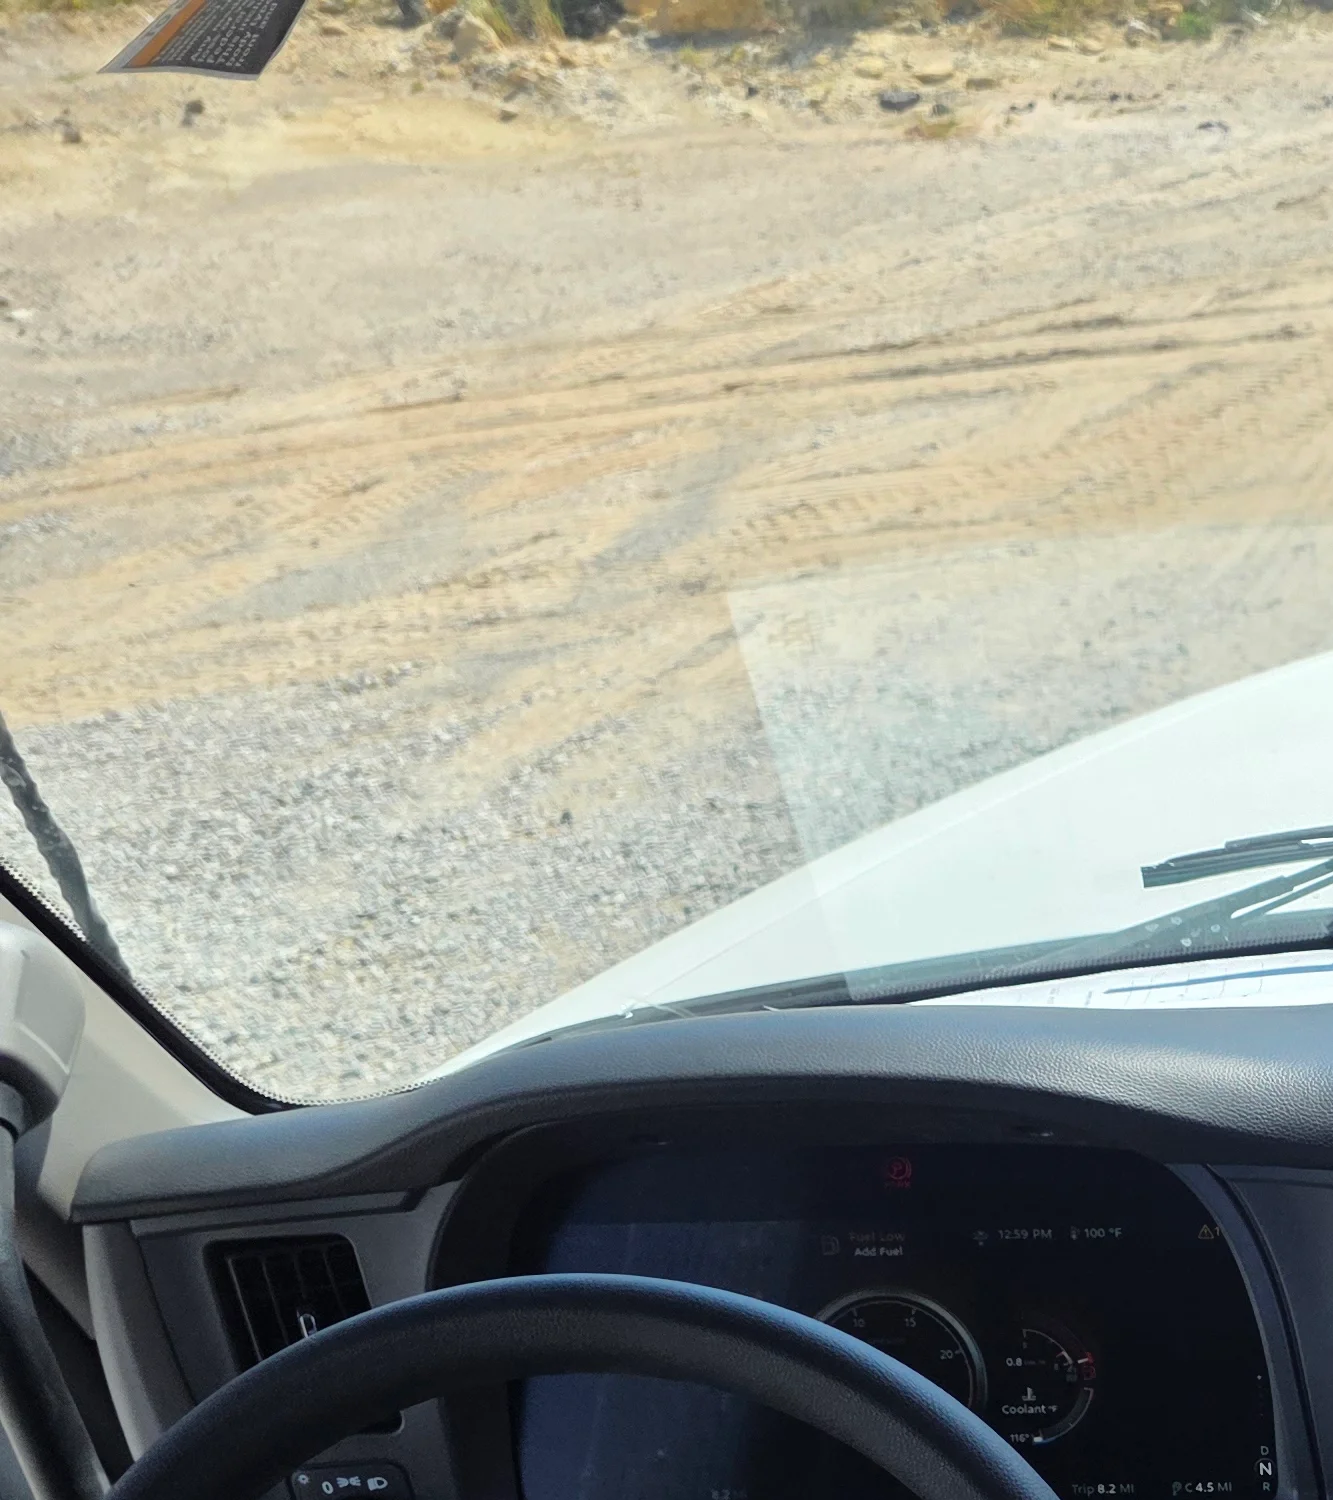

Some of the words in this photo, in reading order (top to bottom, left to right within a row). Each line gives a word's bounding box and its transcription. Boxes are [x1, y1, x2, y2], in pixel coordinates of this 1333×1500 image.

[1032, 1229, 1052, 1240] PM
[1084, 1228, 1106, 1239] 100
[854, 1247, 877, 1257] Add
[880, 1247, 903, 1257] Fuel
[1006, 1357, 1022, 1367] 0.8
[1001, 1404, 1047, 1415] Coolant
[1260, 1445, 1269, 1455] D
[1259, 1462, 1272, 1476] N
[1072, 1483, 1095, 1496] Trip
[1097, 1484, 1117, 1494] 8.2
[1119, 1484, 1135, 1494] MI
[1195, 1482, 1215, 1493] 4.5
[1218, 1482, 1233, 1492] MI
[1262, 1482, 1271, 1492] R
